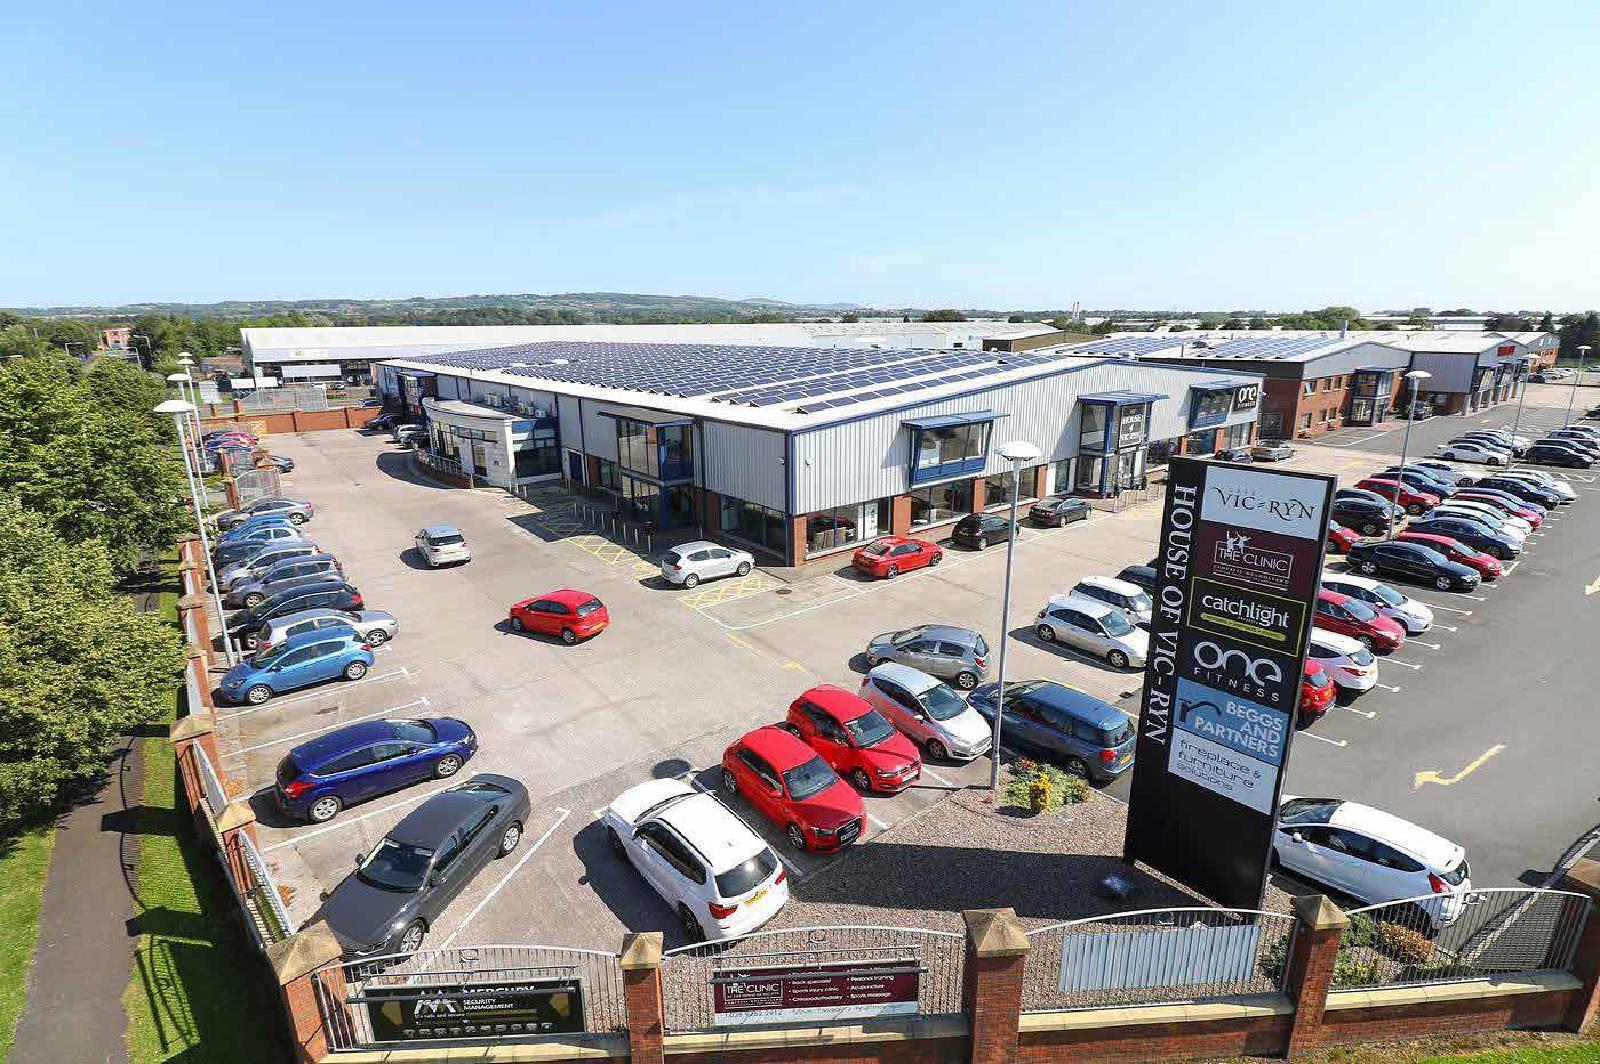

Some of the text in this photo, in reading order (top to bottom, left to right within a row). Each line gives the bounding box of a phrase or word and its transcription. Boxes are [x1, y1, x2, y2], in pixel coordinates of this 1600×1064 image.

[1218, 547, 1288, 571] THE CLINIC
[1145, 484, 1197, 746] HOUSE OF VIC-RYN
[1202, 595, 1290, 628] catchlight
[1193, 667, 1280, 702] FITNESS
[1226, 701, 1282, 731] BEGGS
[1194, 716, 1280, 757] PARTNERS
[1240, 721, 1280, 743] AND
[1178, 750, 1254, 789] furniture
[1180, 739, 1262, 780] fireplace &
[1177, 762, 1233, 791] solutions
[727, 983, 780, 994] THE CLINIC
[463, 1003, 515, 1011] MANAGEMENT
